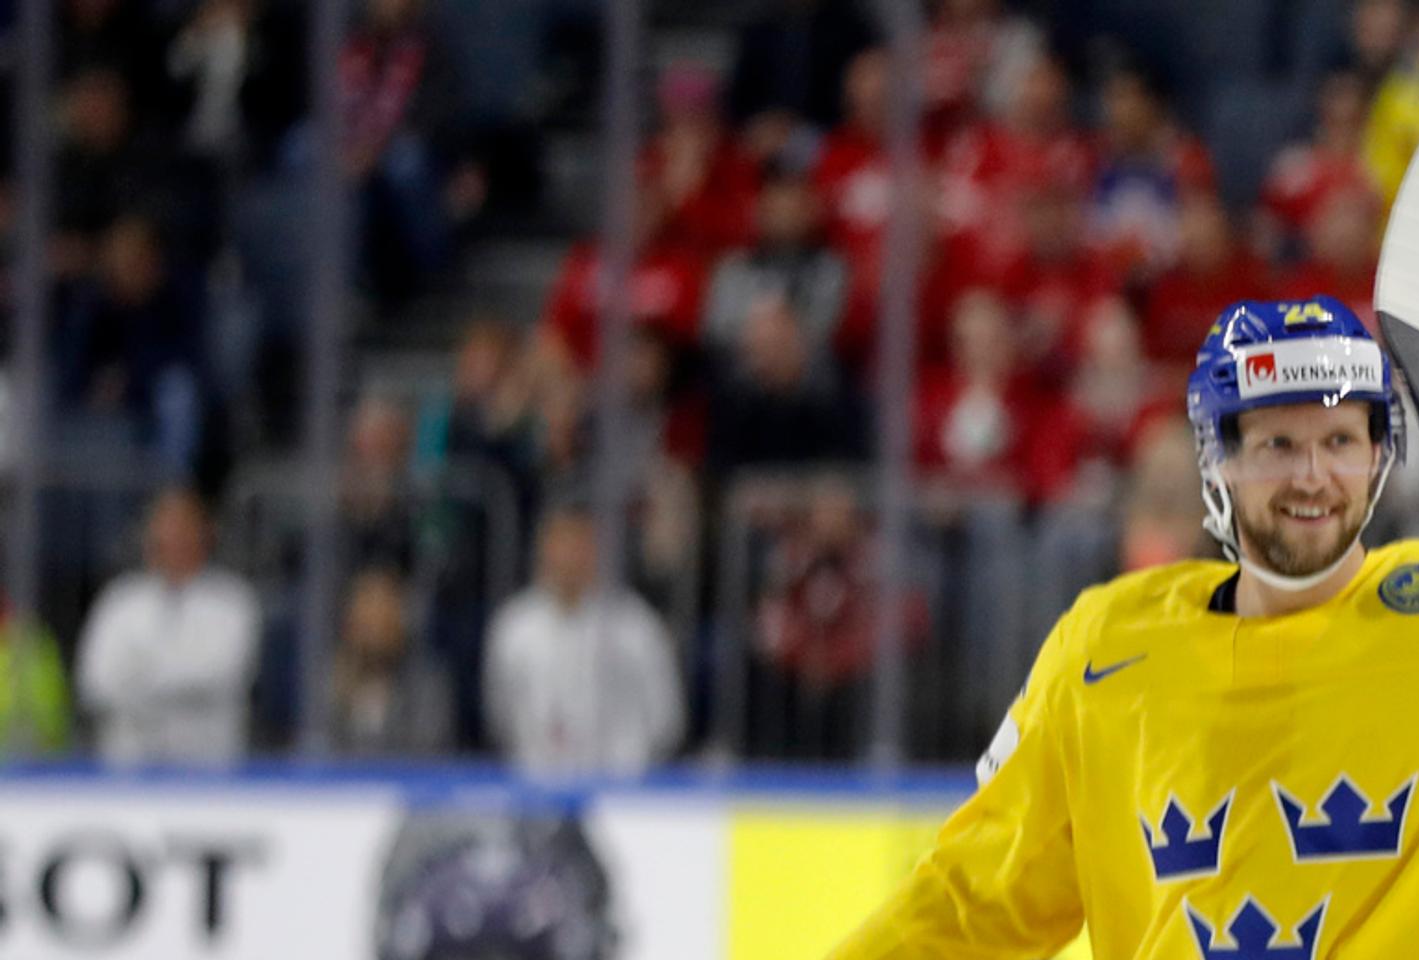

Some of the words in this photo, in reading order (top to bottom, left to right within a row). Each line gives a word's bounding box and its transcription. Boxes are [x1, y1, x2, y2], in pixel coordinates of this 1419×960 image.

[1282, 365, 1347, 383] SVENSKA
[1351, 364, 1376, 382] SPEL
[0, 826, 280, 955] OT
